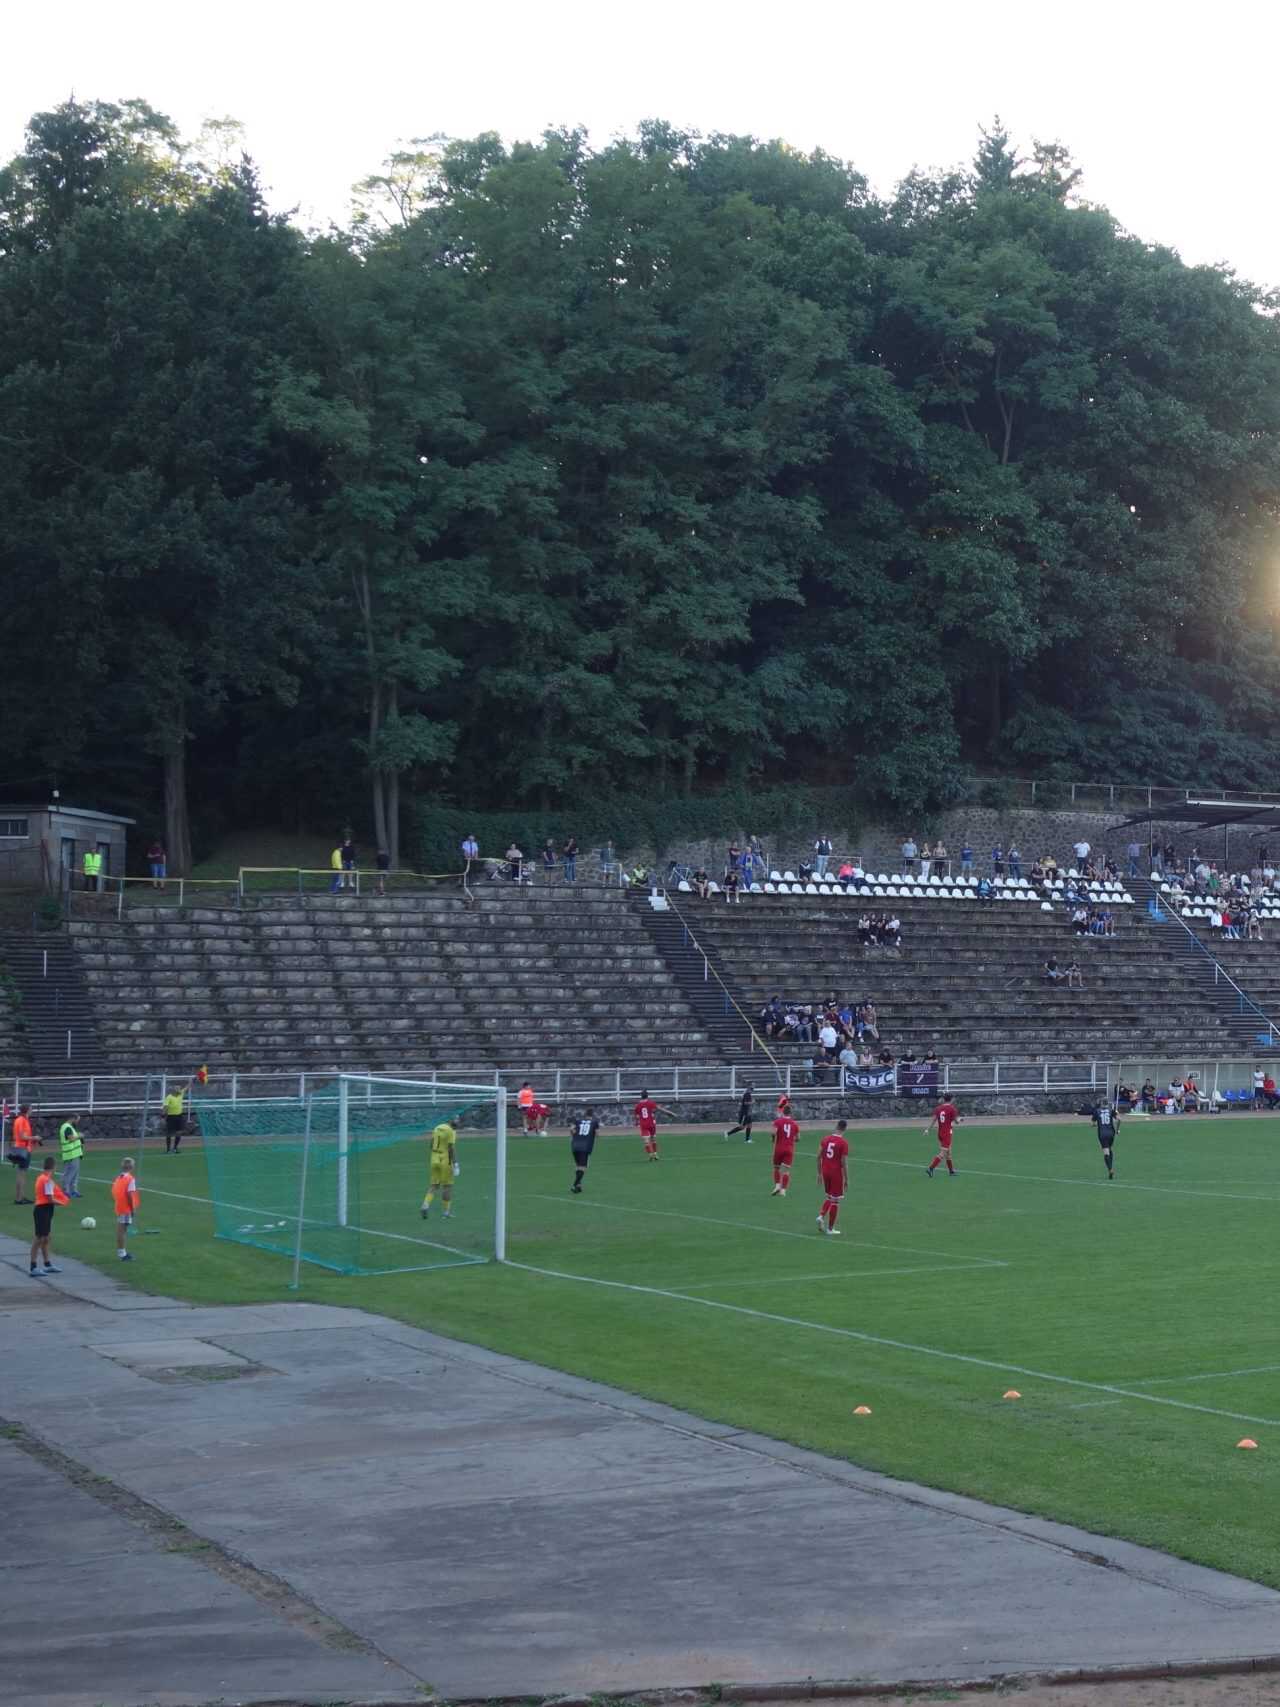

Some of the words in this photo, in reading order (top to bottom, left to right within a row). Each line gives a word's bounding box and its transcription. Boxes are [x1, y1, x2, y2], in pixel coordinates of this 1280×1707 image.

[641, 1107, 649, 1119] 8
[940, 1111, 946, 1123] 6
[783, 1123, 791, 1138] 4
[826, 1142, 835, 1159] 5
